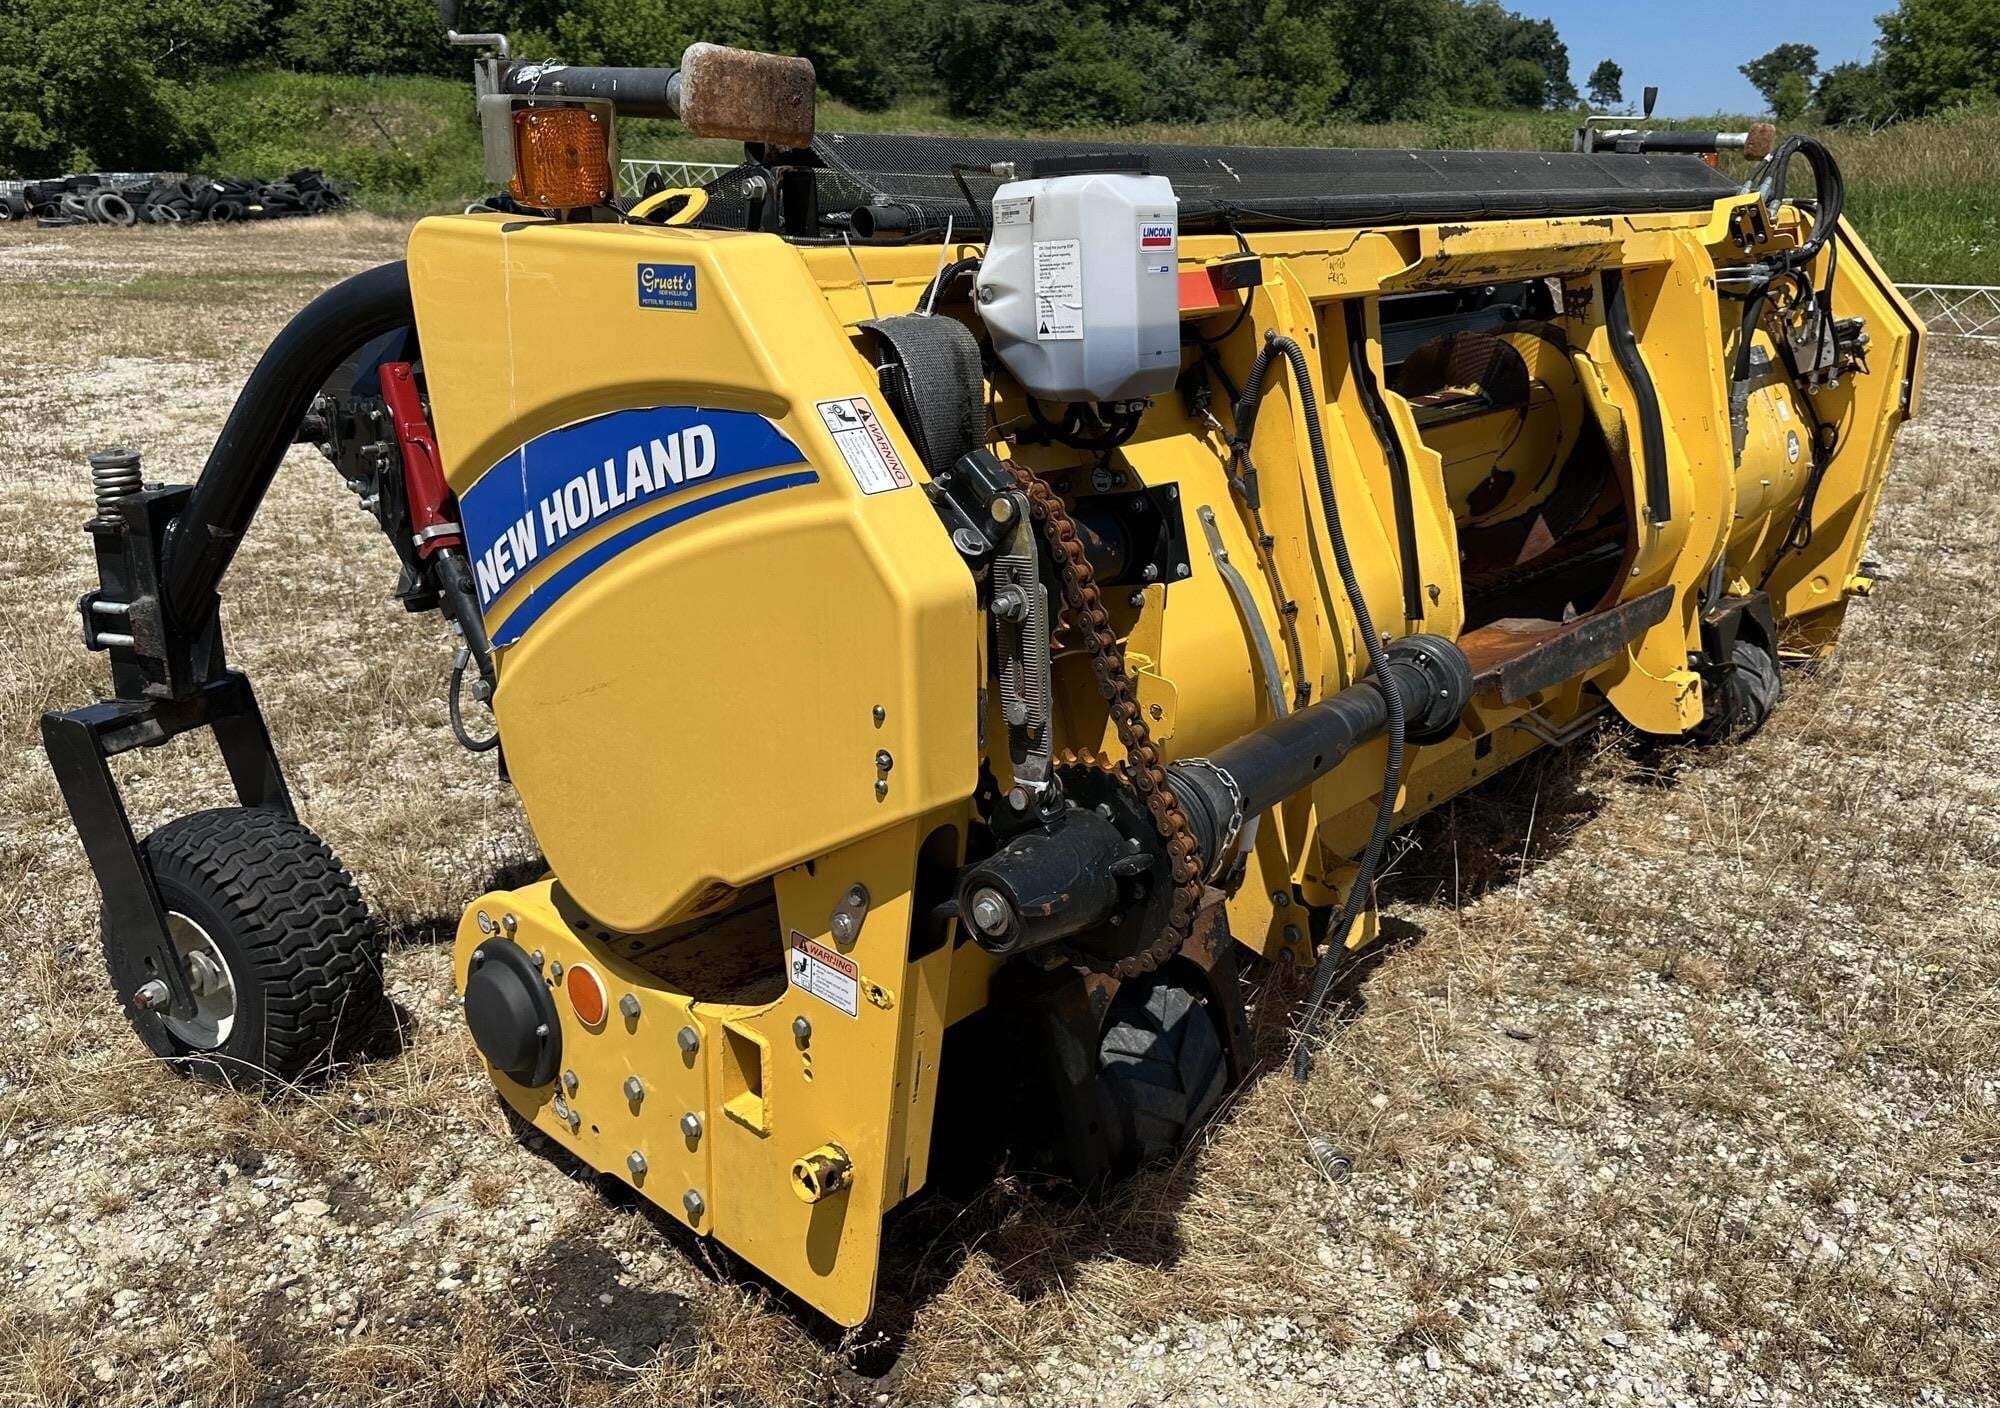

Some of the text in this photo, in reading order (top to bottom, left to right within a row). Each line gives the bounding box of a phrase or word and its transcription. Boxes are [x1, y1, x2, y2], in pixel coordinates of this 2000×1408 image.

[1143, 227, 1172, 237] LINCOLN
[641, 267, 692, 293] Gruett's
[868, 423, 906, 480] WARNING
[476, 510, 538, 604] NEW
[540, 424, 716, 547] HOLLAND
[810, 945, 852, 973] WARNING
